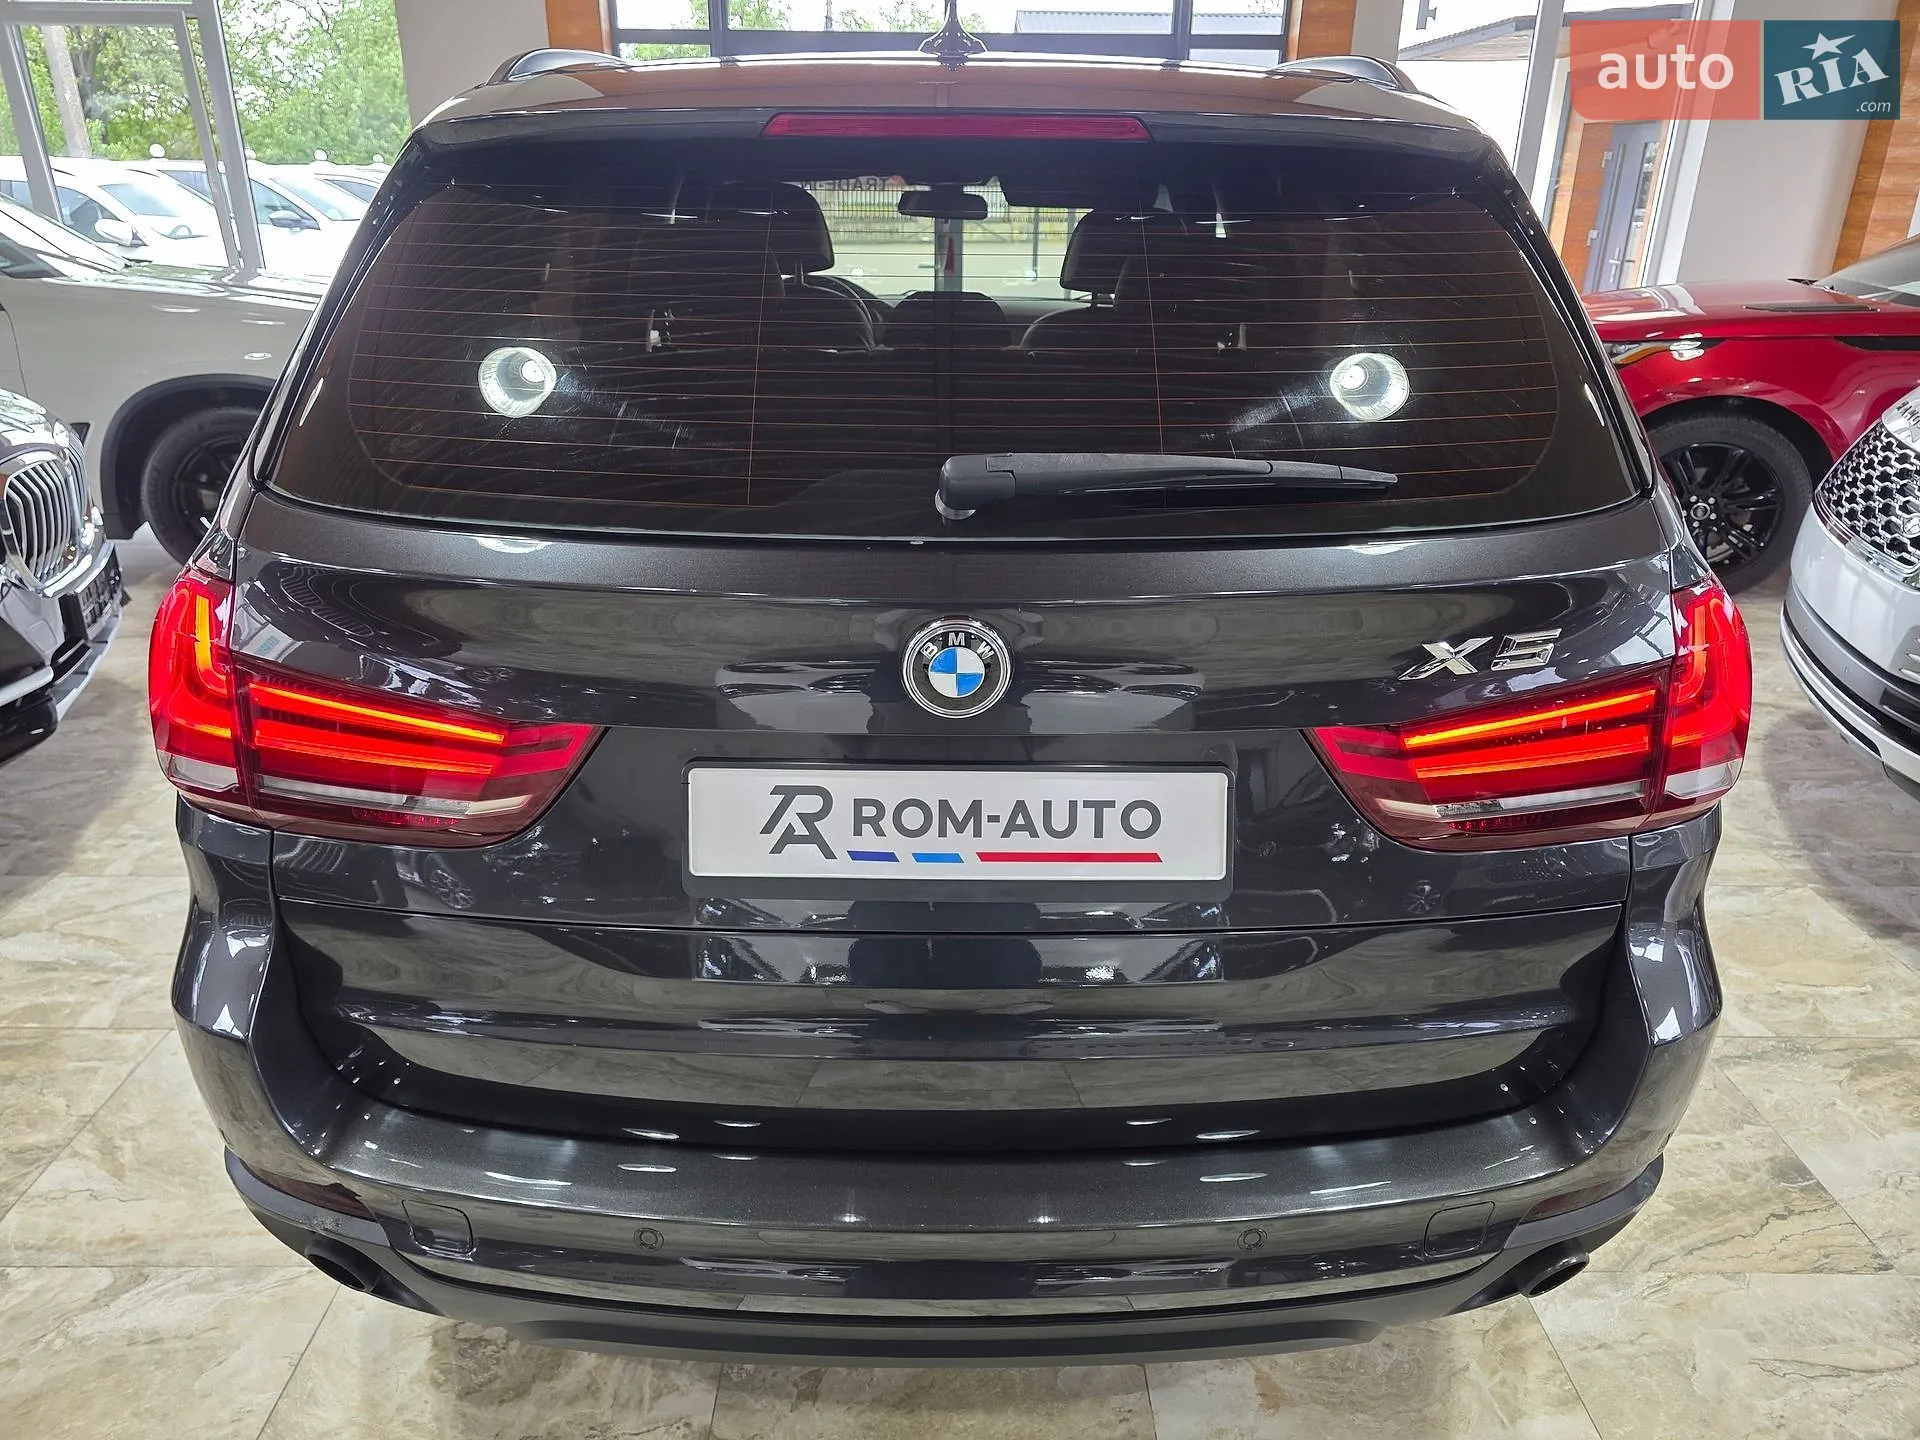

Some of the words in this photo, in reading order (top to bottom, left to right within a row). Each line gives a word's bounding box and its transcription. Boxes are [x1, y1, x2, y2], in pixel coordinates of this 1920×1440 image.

[920, 632, 995, 660] BMW
[1398, 628, 1562, 681] X5
[852, 798, 1162, 840] ROM-AUTO
